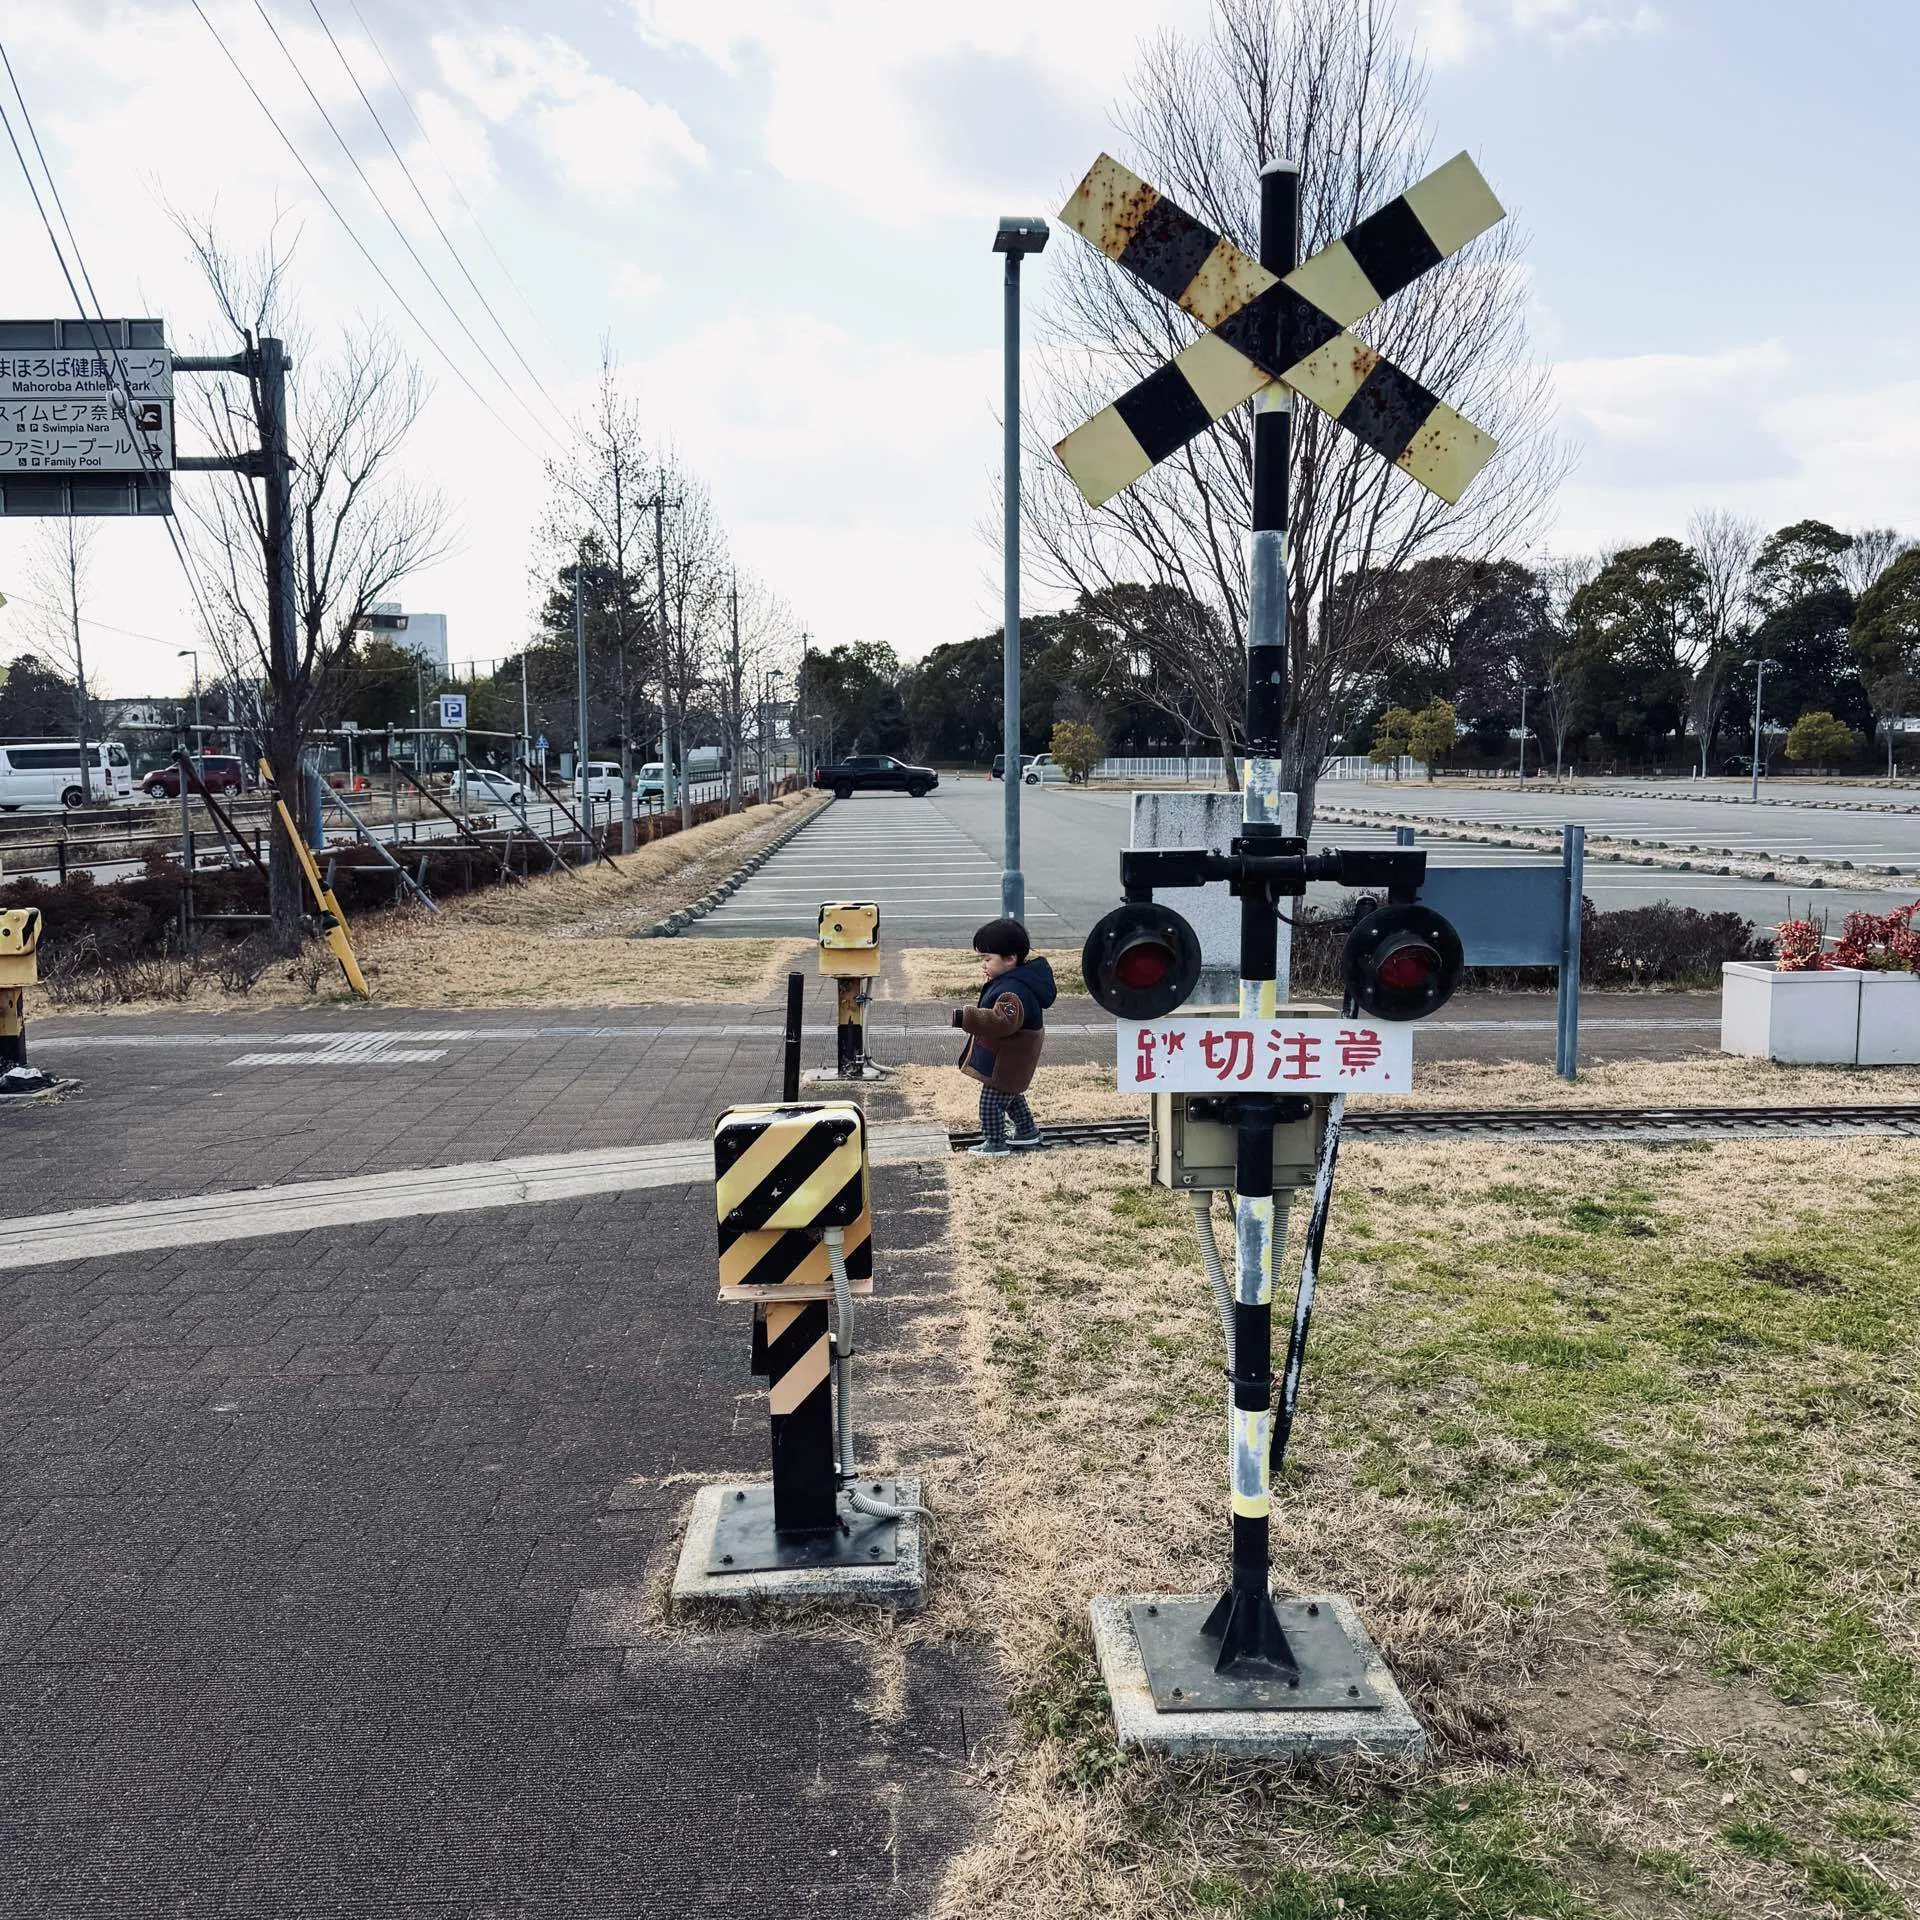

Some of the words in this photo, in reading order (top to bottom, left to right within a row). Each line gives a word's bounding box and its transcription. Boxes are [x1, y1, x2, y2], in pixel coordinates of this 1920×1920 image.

[0, 357, 165, 378] まほろば健康パーク
[12, 381, 72, 392] Mahoroba
[42, 424, 84, 434] Swimpia
[86, 424, 110, 432] Nara
[0, 438, 132, 455] ファミリープール
[44, 458, 76, 468] Family
[79, 458, 102, 466] Pool
